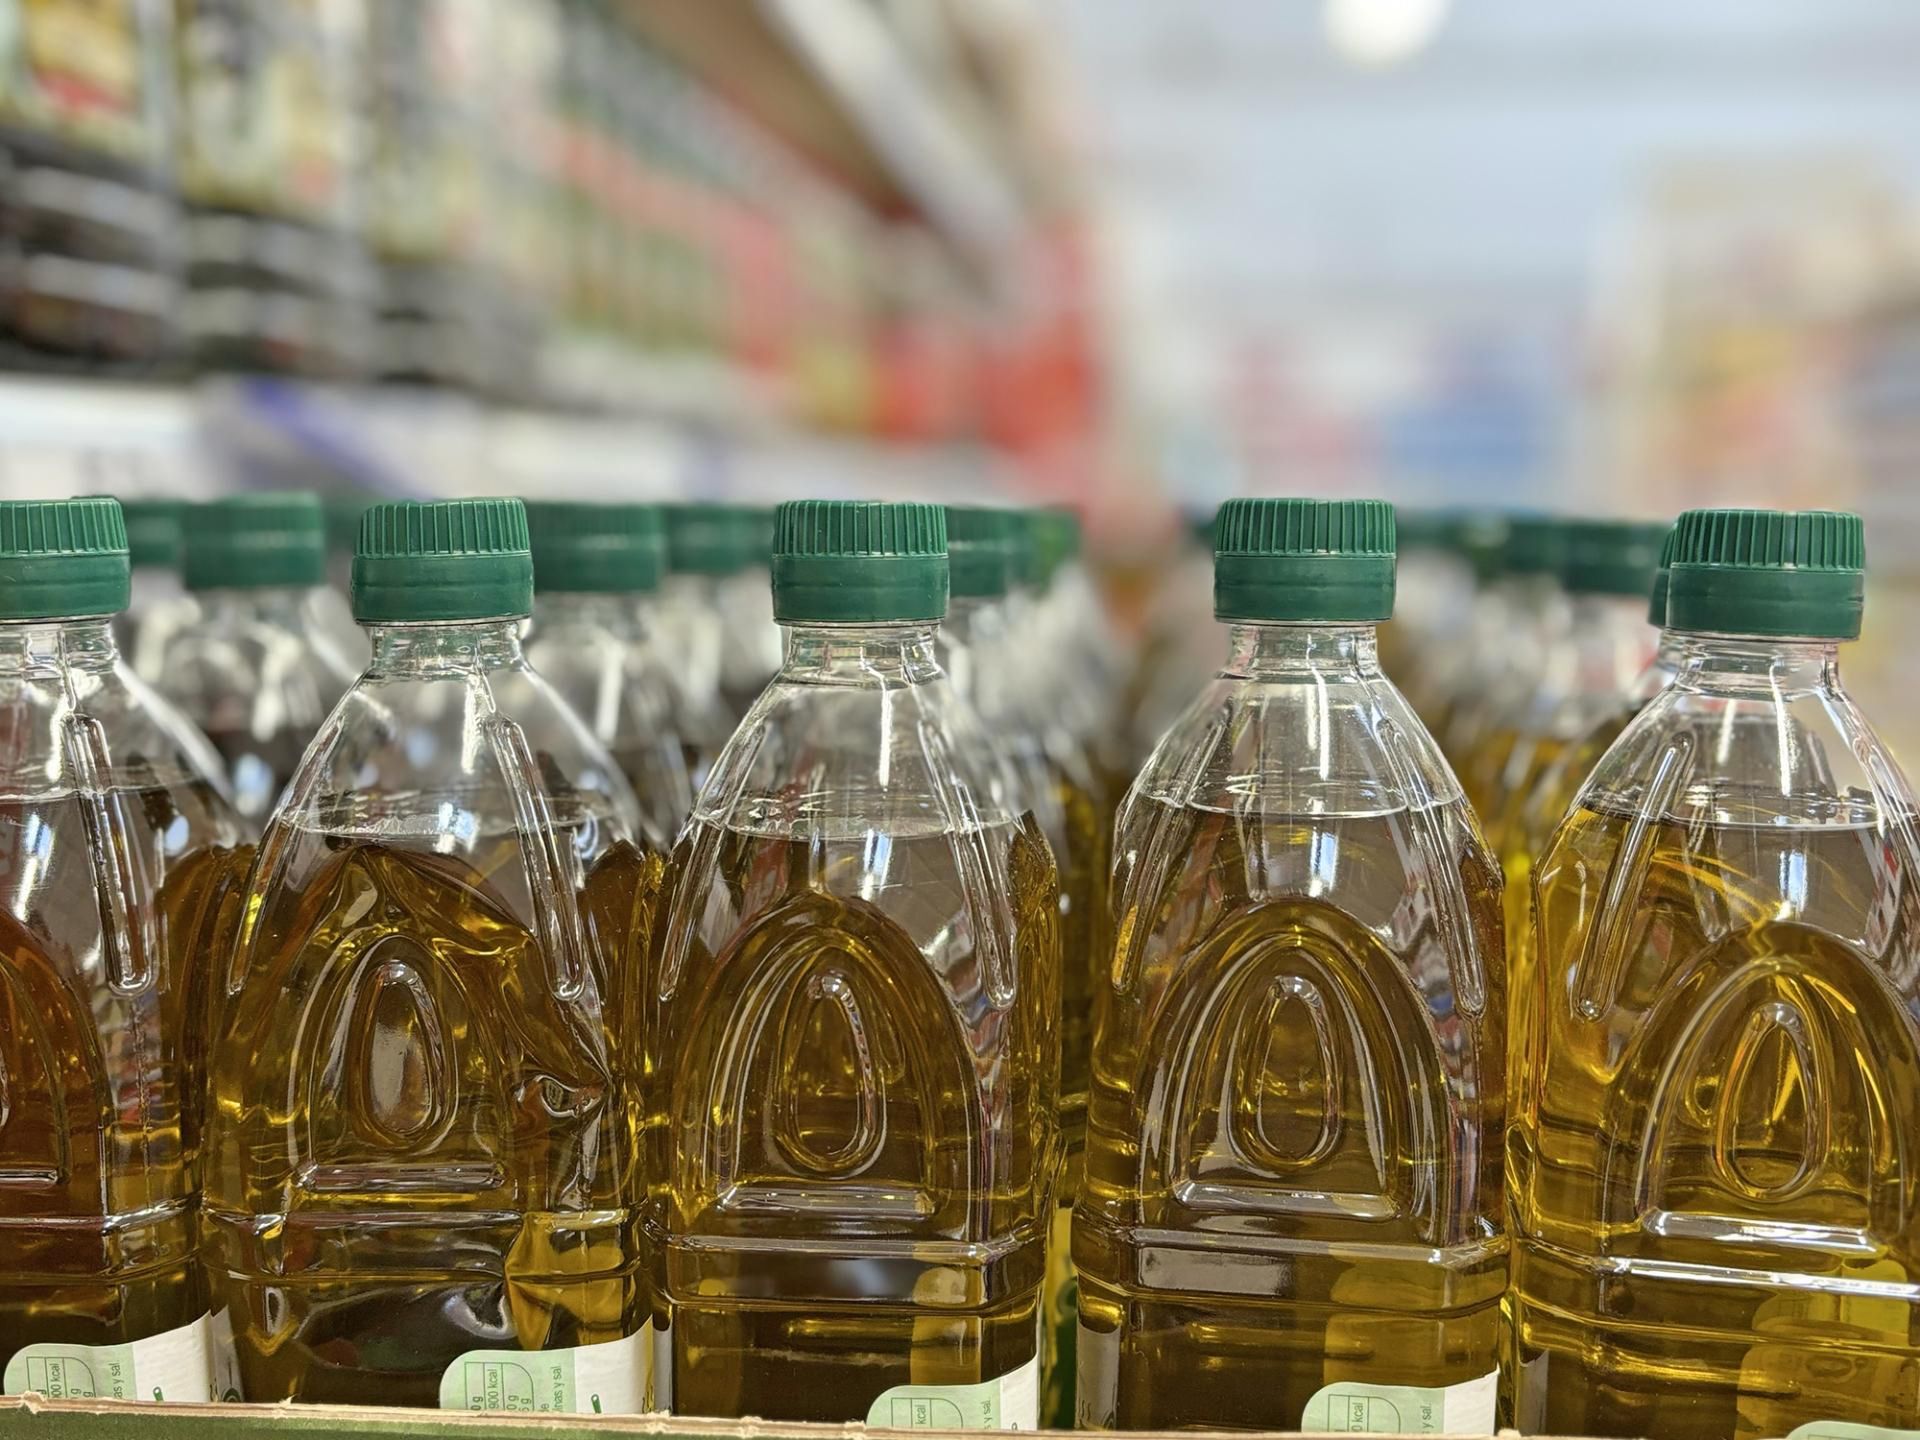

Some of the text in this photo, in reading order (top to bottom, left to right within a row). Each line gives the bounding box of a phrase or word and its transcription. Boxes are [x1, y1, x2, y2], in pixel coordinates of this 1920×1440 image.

[49, 1363, 61, 1382] kcal
[487, 1369, 498, 1388] kcal
[914, 1405, 927, 1424] kcal
[1352, 1402, 1364, 1422] kcal
